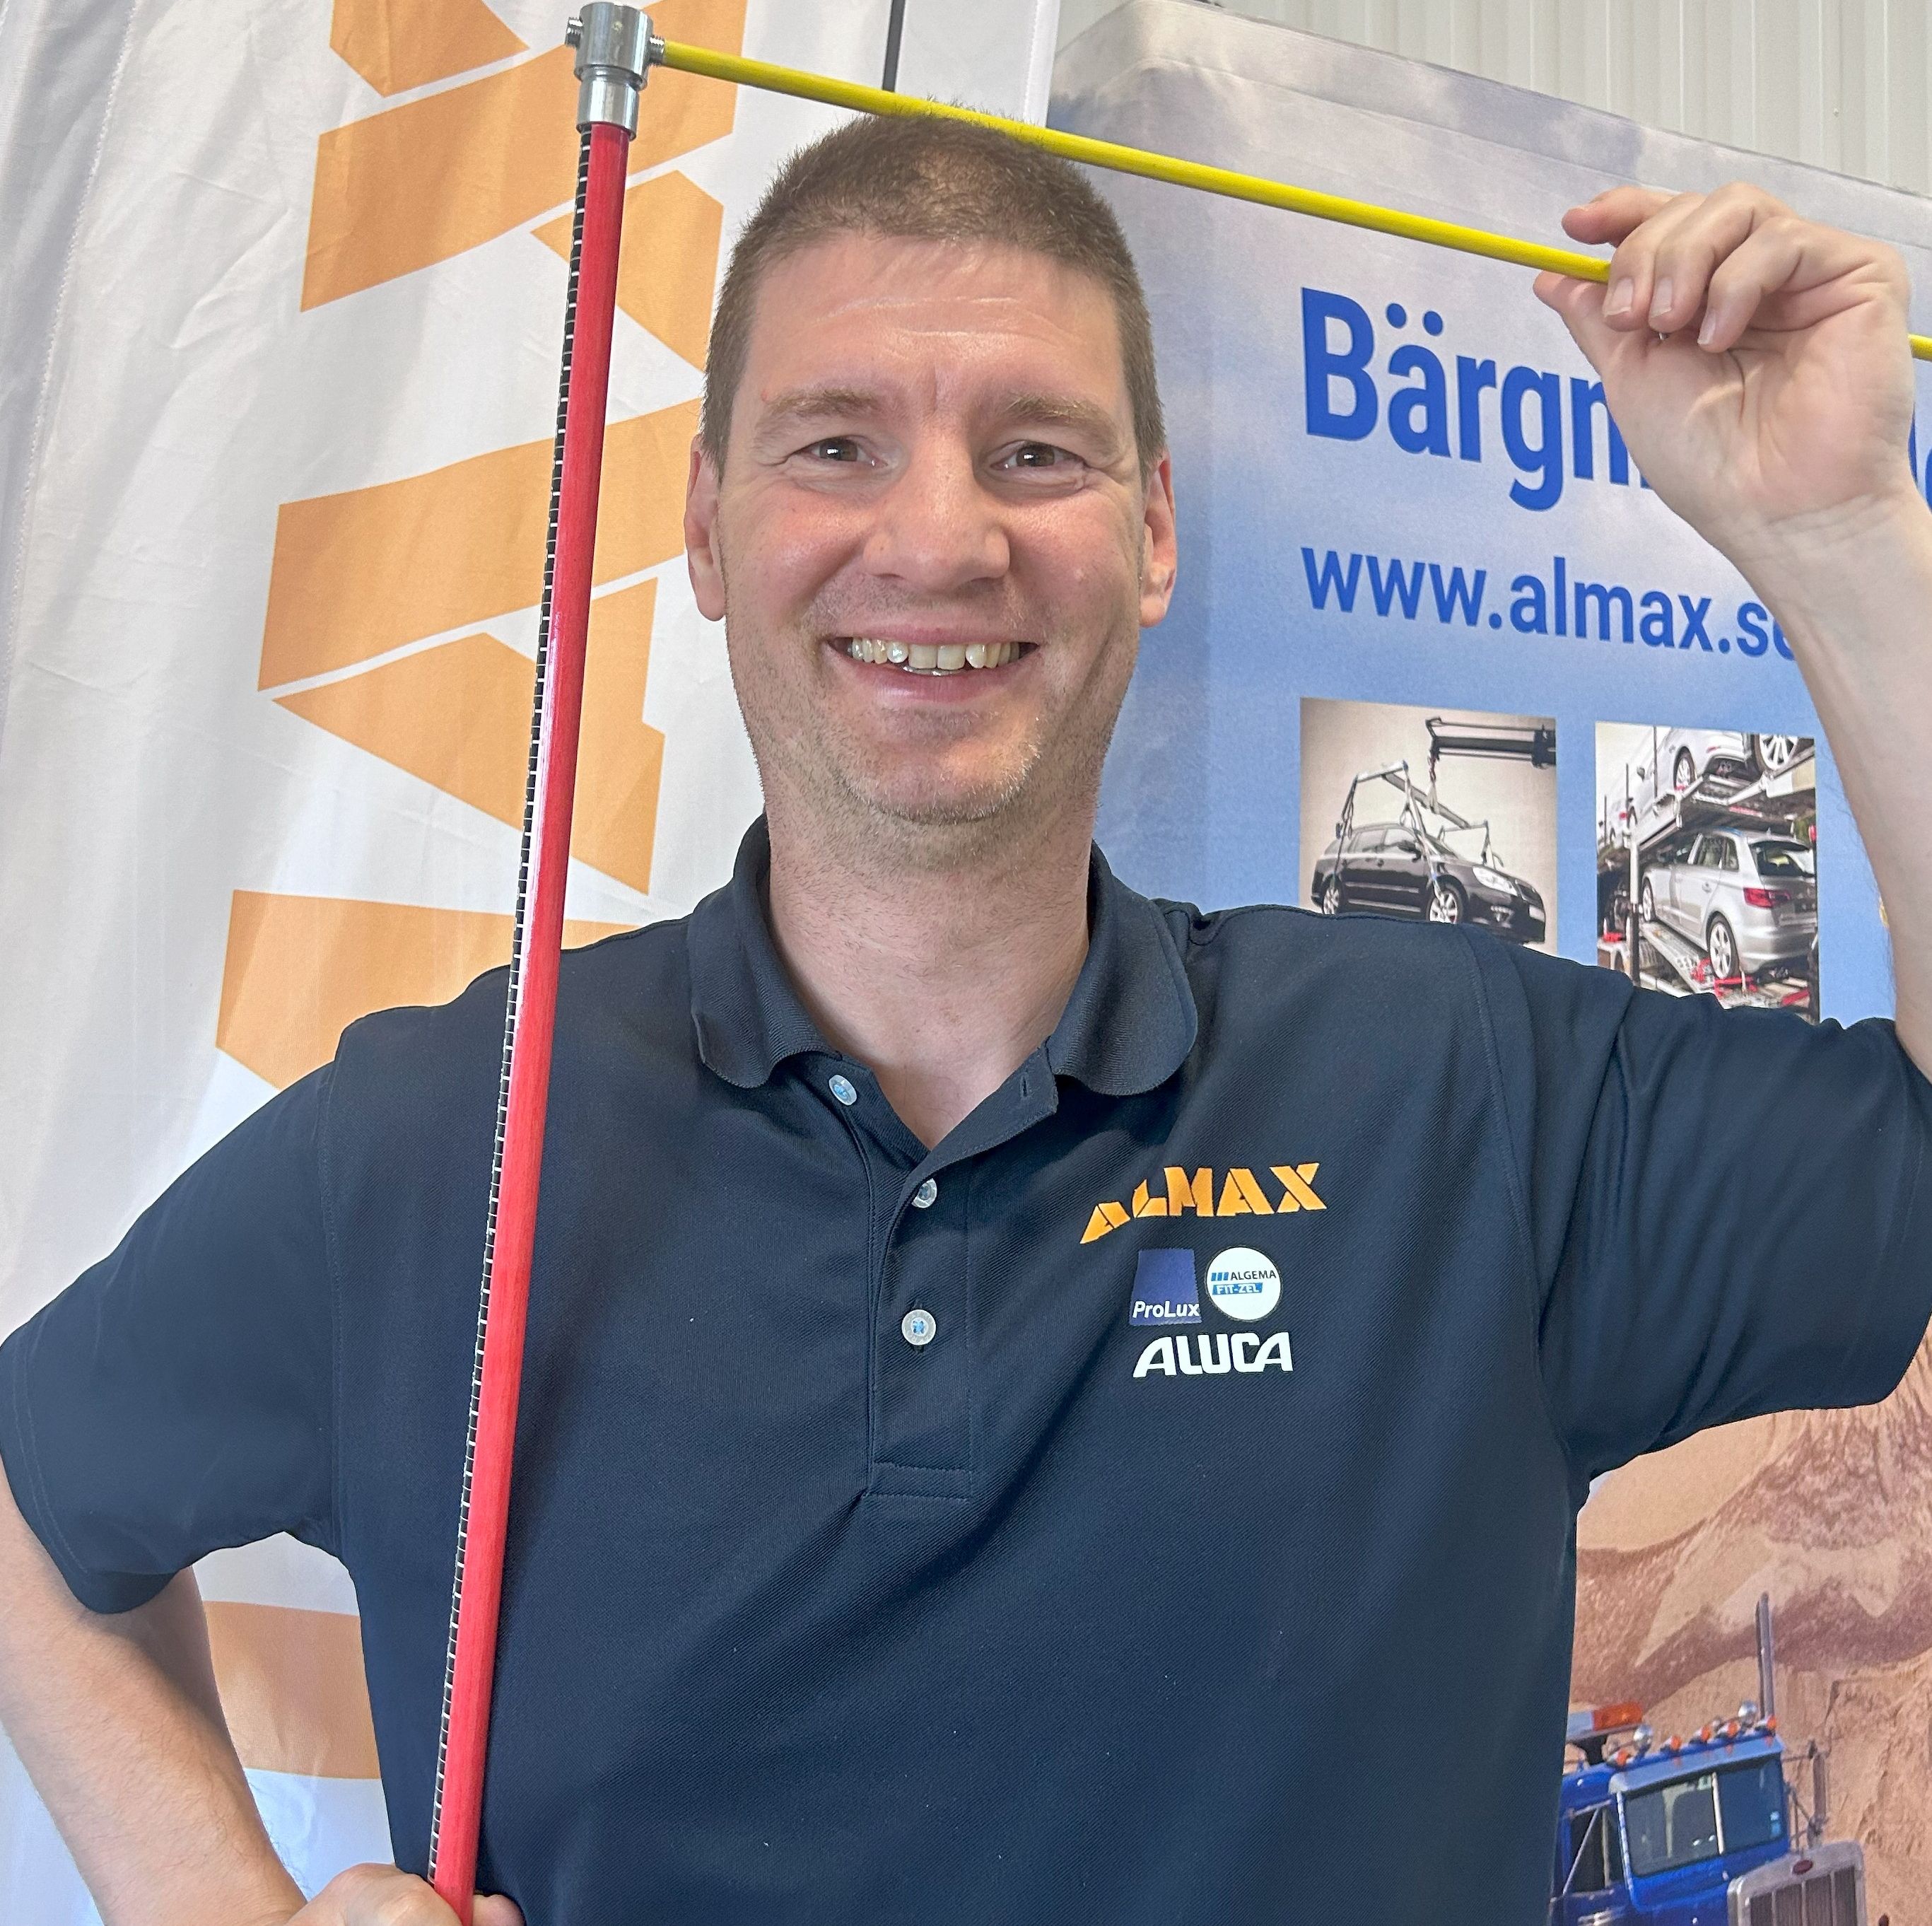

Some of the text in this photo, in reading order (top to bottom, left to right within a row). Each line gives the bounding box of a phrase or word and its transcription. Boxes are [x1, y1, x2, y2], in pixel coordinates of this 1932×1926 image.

[1300, 286, 1651, 511] Bärgn
[1079, 1162, 1328, 1244] ALMAX
[1216, 1283, 1261, 1295] FIT-ZEL
[1230, 1270, 1277, 1281] ALGEMA
[1132, 1300, 1200, 1319] ProLux
[1132, 1331, 1294, 1378] ALUCA
